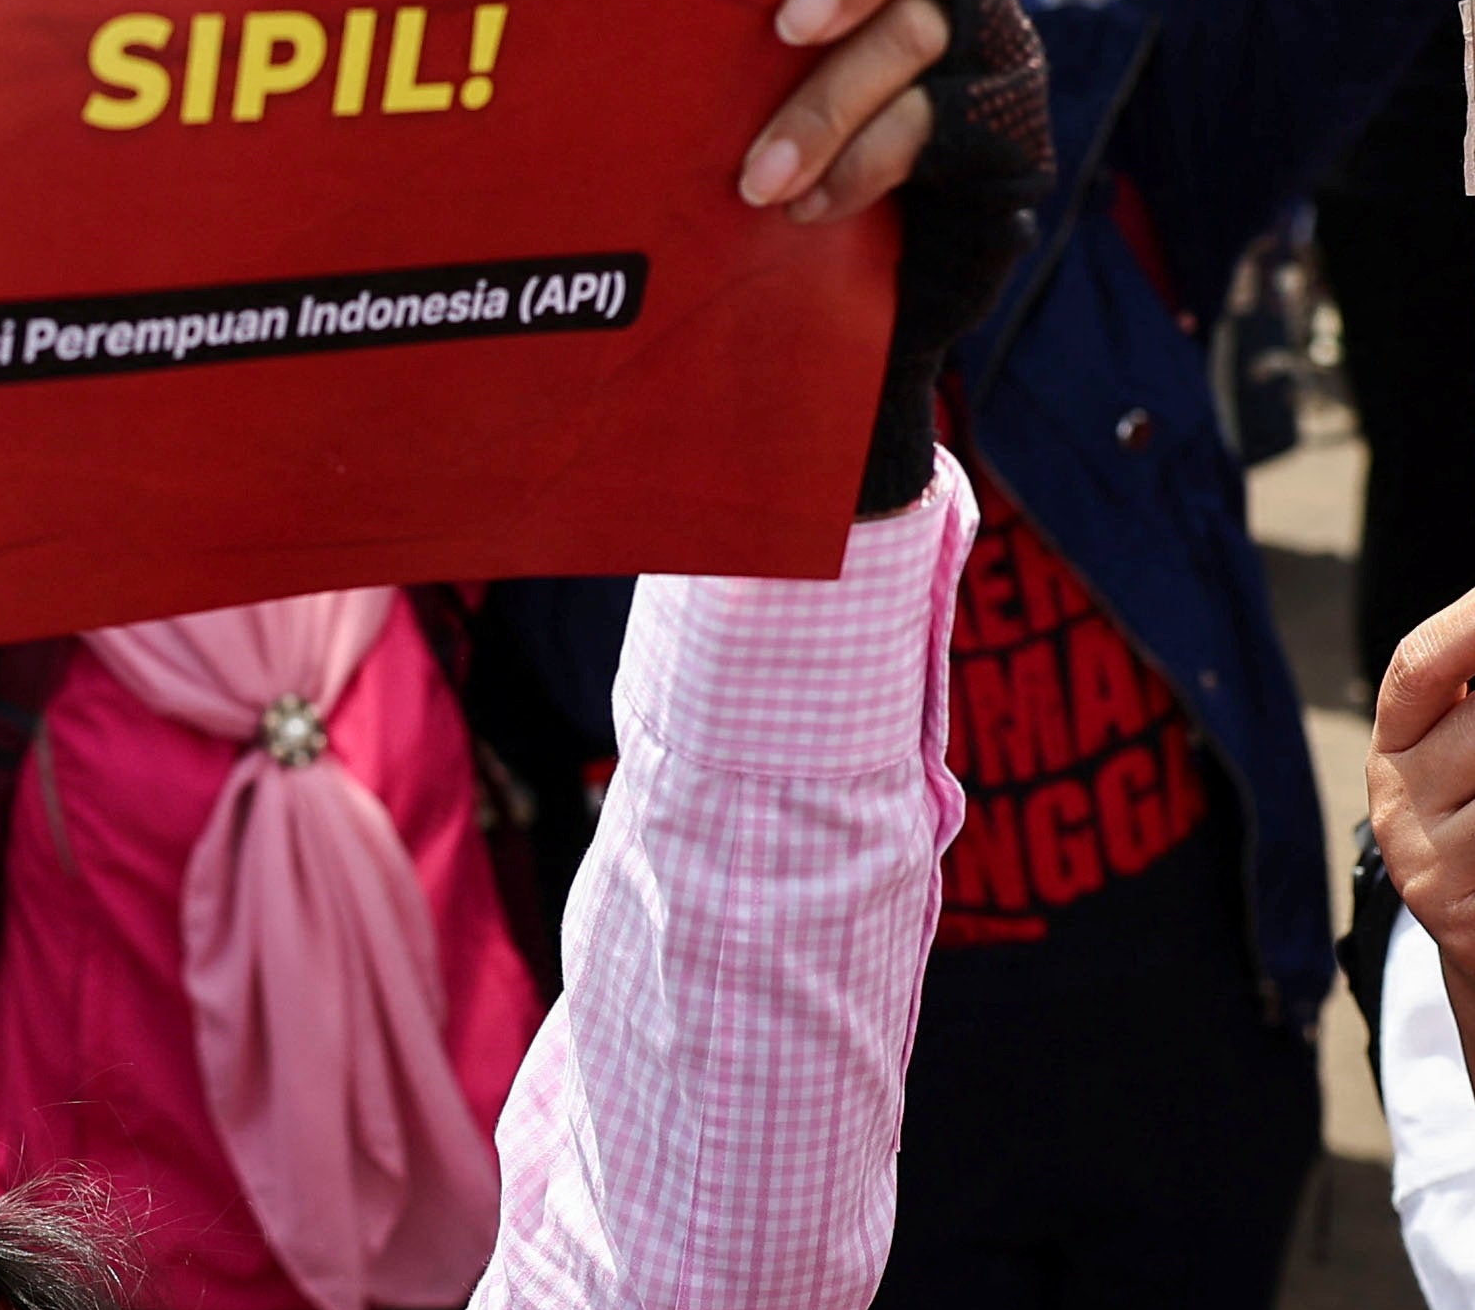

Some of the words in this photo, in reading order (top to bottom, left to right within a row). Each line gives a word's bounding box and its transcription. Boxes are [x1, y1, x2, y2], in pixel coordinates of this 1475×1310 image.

[83, 4, 508, 129] SIPIL!
[23, 301, 290, 365] Perempuan
[296, 279, 510, 337] Indonesia
[518, 270, 628, 325] (API)
